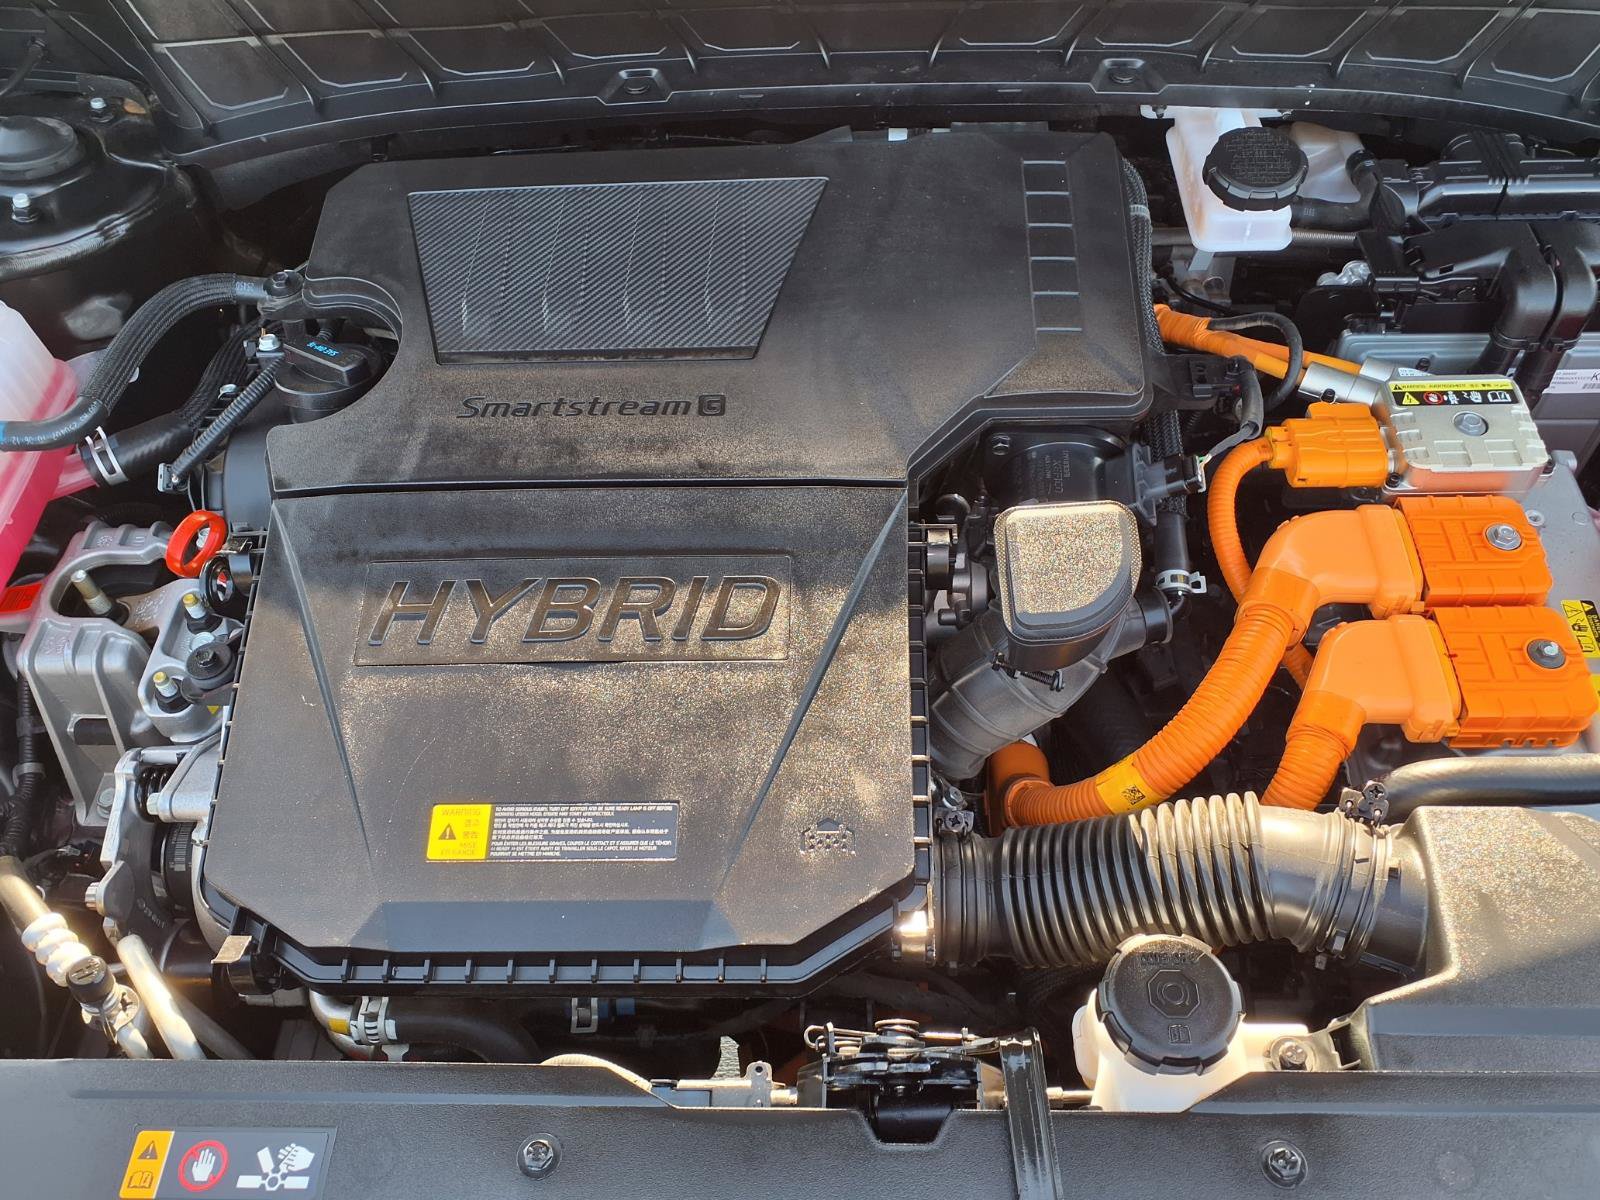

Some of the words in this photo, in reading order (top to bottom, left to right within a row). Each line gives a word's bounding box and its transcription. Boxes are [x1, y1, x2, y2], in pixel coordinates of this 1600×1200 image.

[456, 396, 692, 418] Smartstream
[368, 576, 781, 645] HYBRID
[442, 808, 480, 816] WARNING
